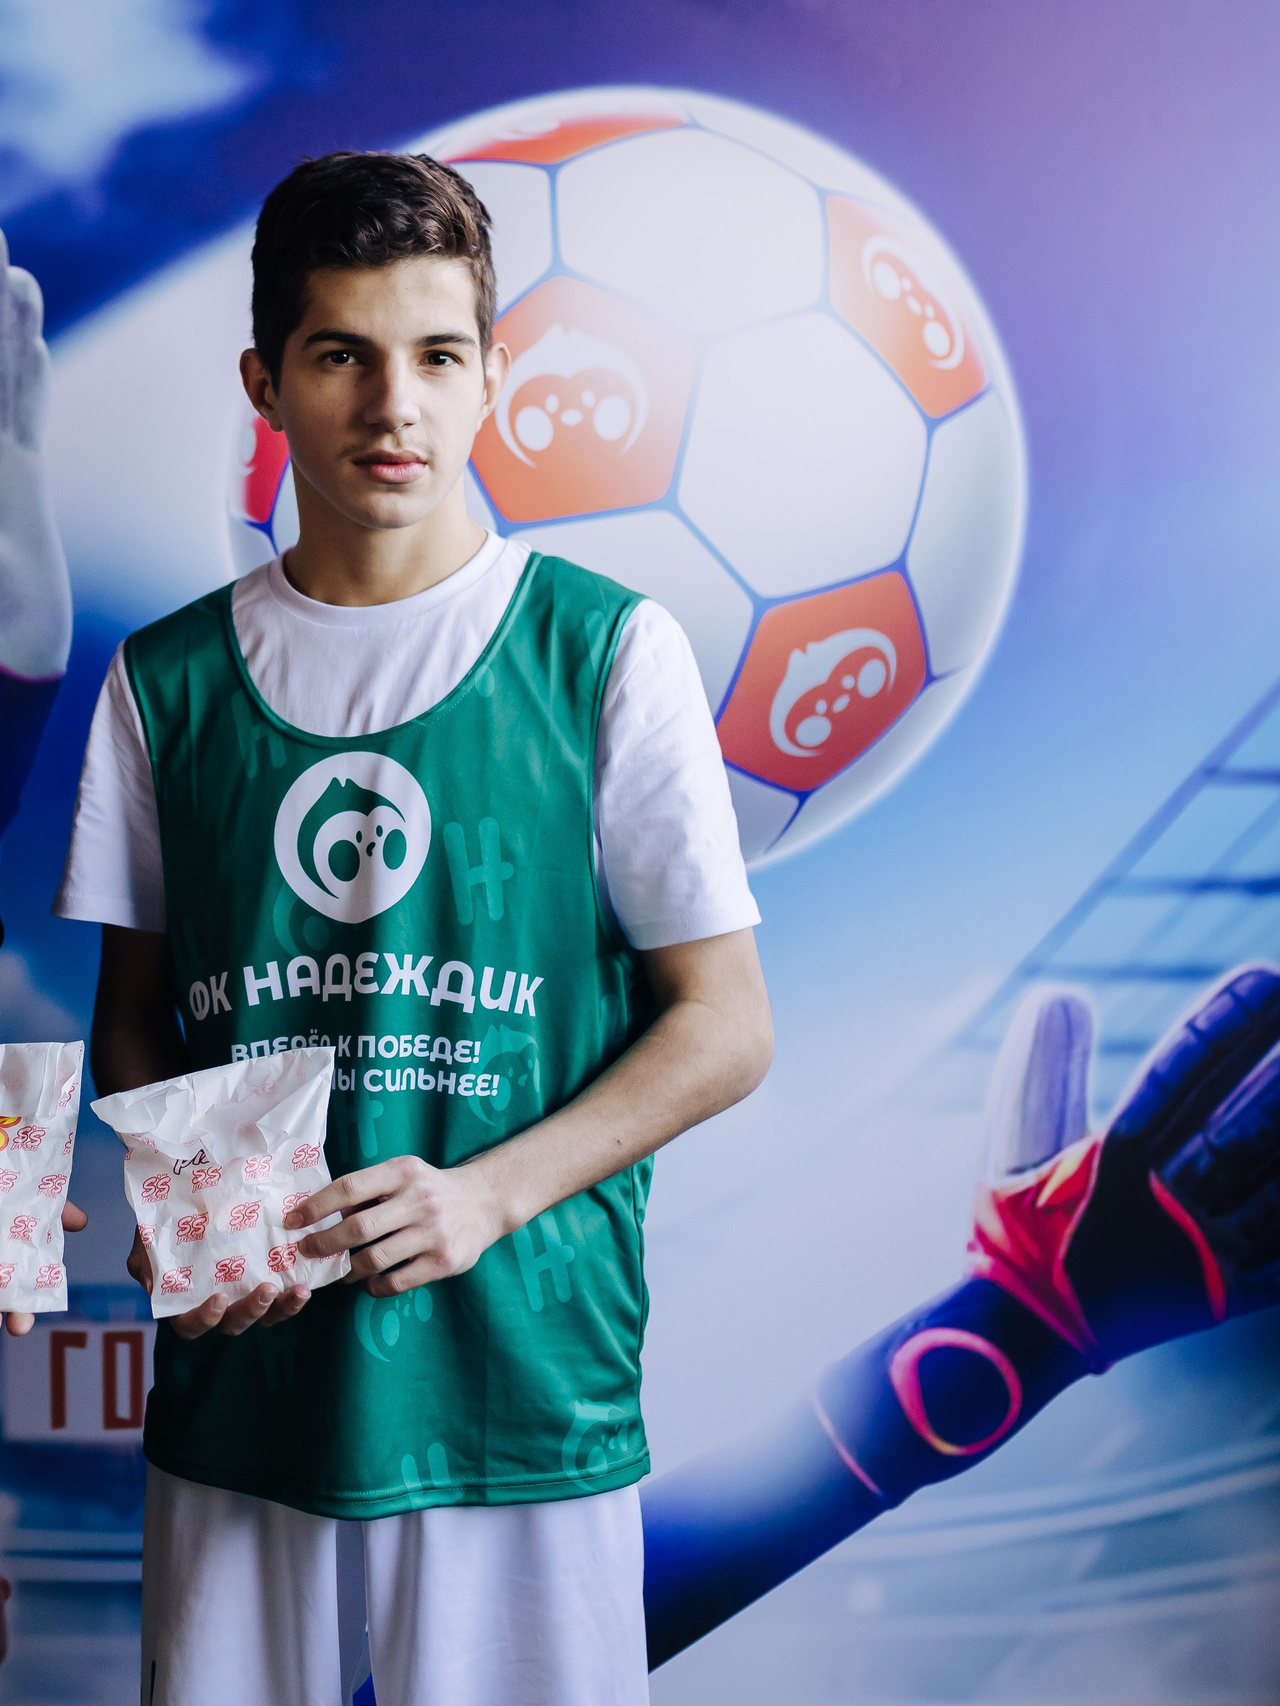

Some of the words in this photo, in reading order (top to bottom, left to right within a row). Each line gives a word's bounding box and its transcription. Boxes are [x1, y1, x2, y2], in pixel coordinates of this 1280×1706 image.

[189, 971, 232, 1021] ФК
[243, 952, 545, 1017] НАДЕЖДИК
[338, 1035, 352, 1058] К
[357, 1035, 482, 1064] ПОБЕДЕ!
[363, 1067, 501, 1097] СИЛЬНЕЕ!
